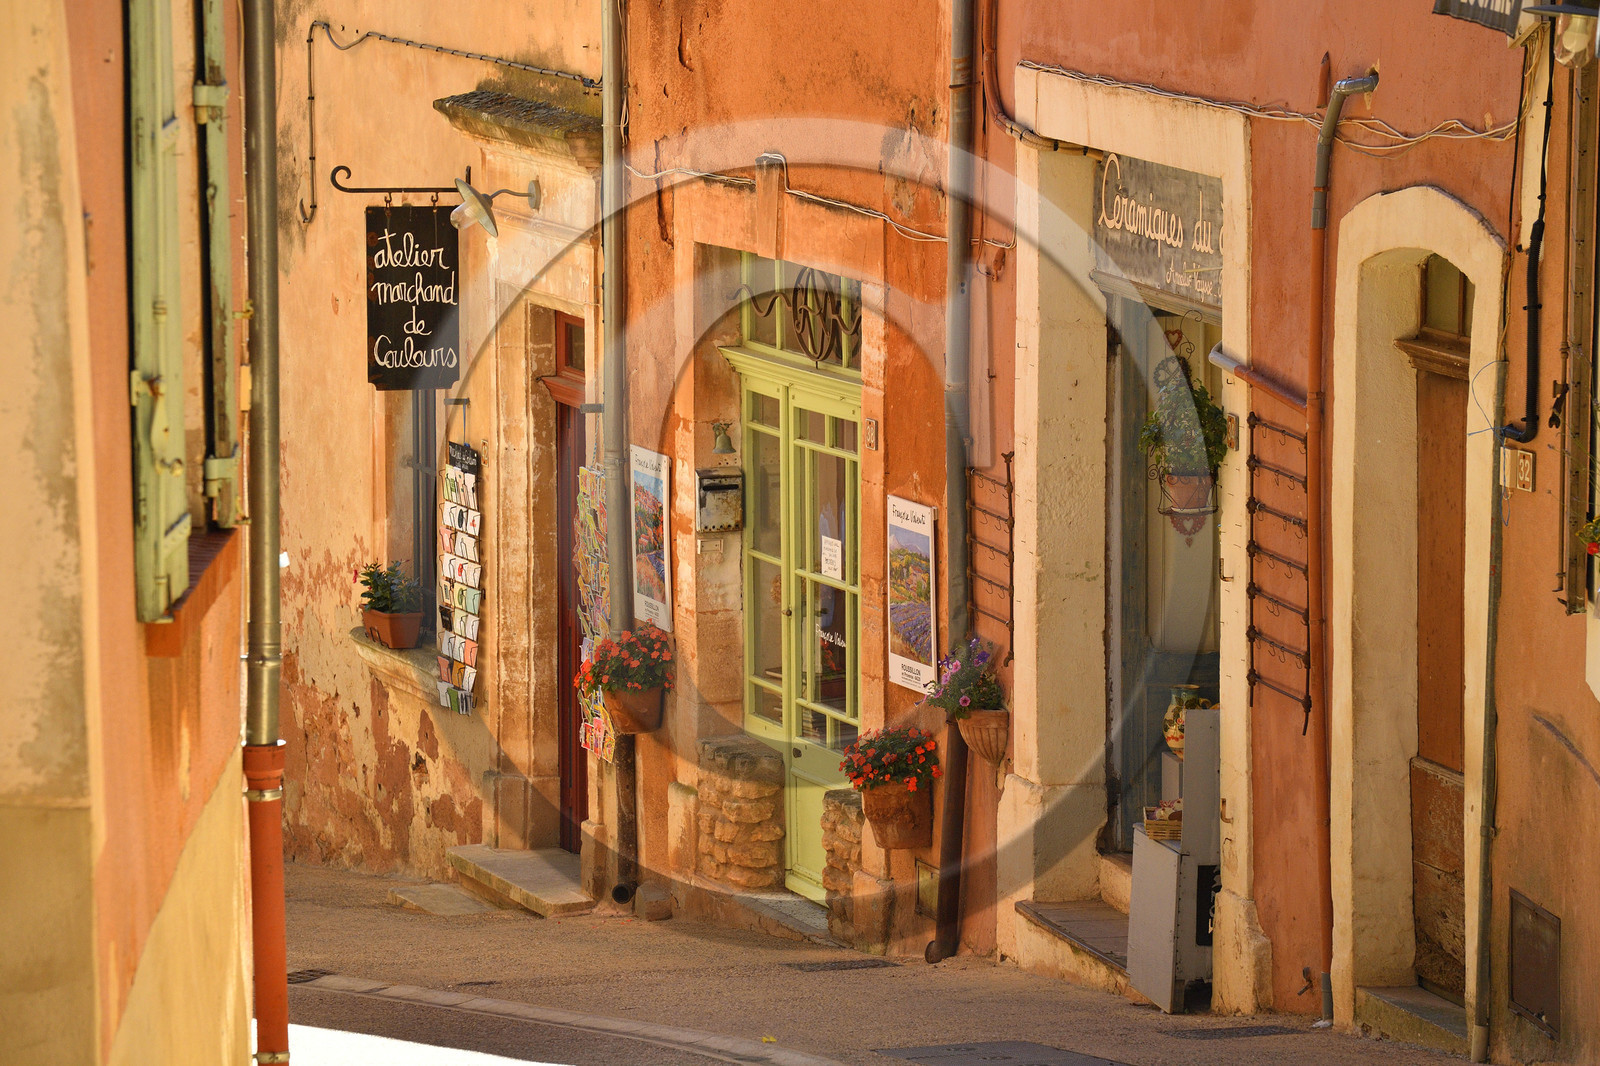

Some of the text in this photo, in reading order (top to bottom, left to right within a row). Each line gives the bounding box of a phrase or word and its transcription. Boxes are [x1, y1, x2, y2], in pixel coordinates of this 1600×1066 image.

[1191, 190, 1214, 254] du
[374, 228, 450, 269] atelier
[371, 271, 458, 306] marchand
[403, 306, 432, 336] de
[373, 334, 458, 369] Couleurs
[866, 425, 875, 444] 38
[1518, 458, 1531, 482] 32
